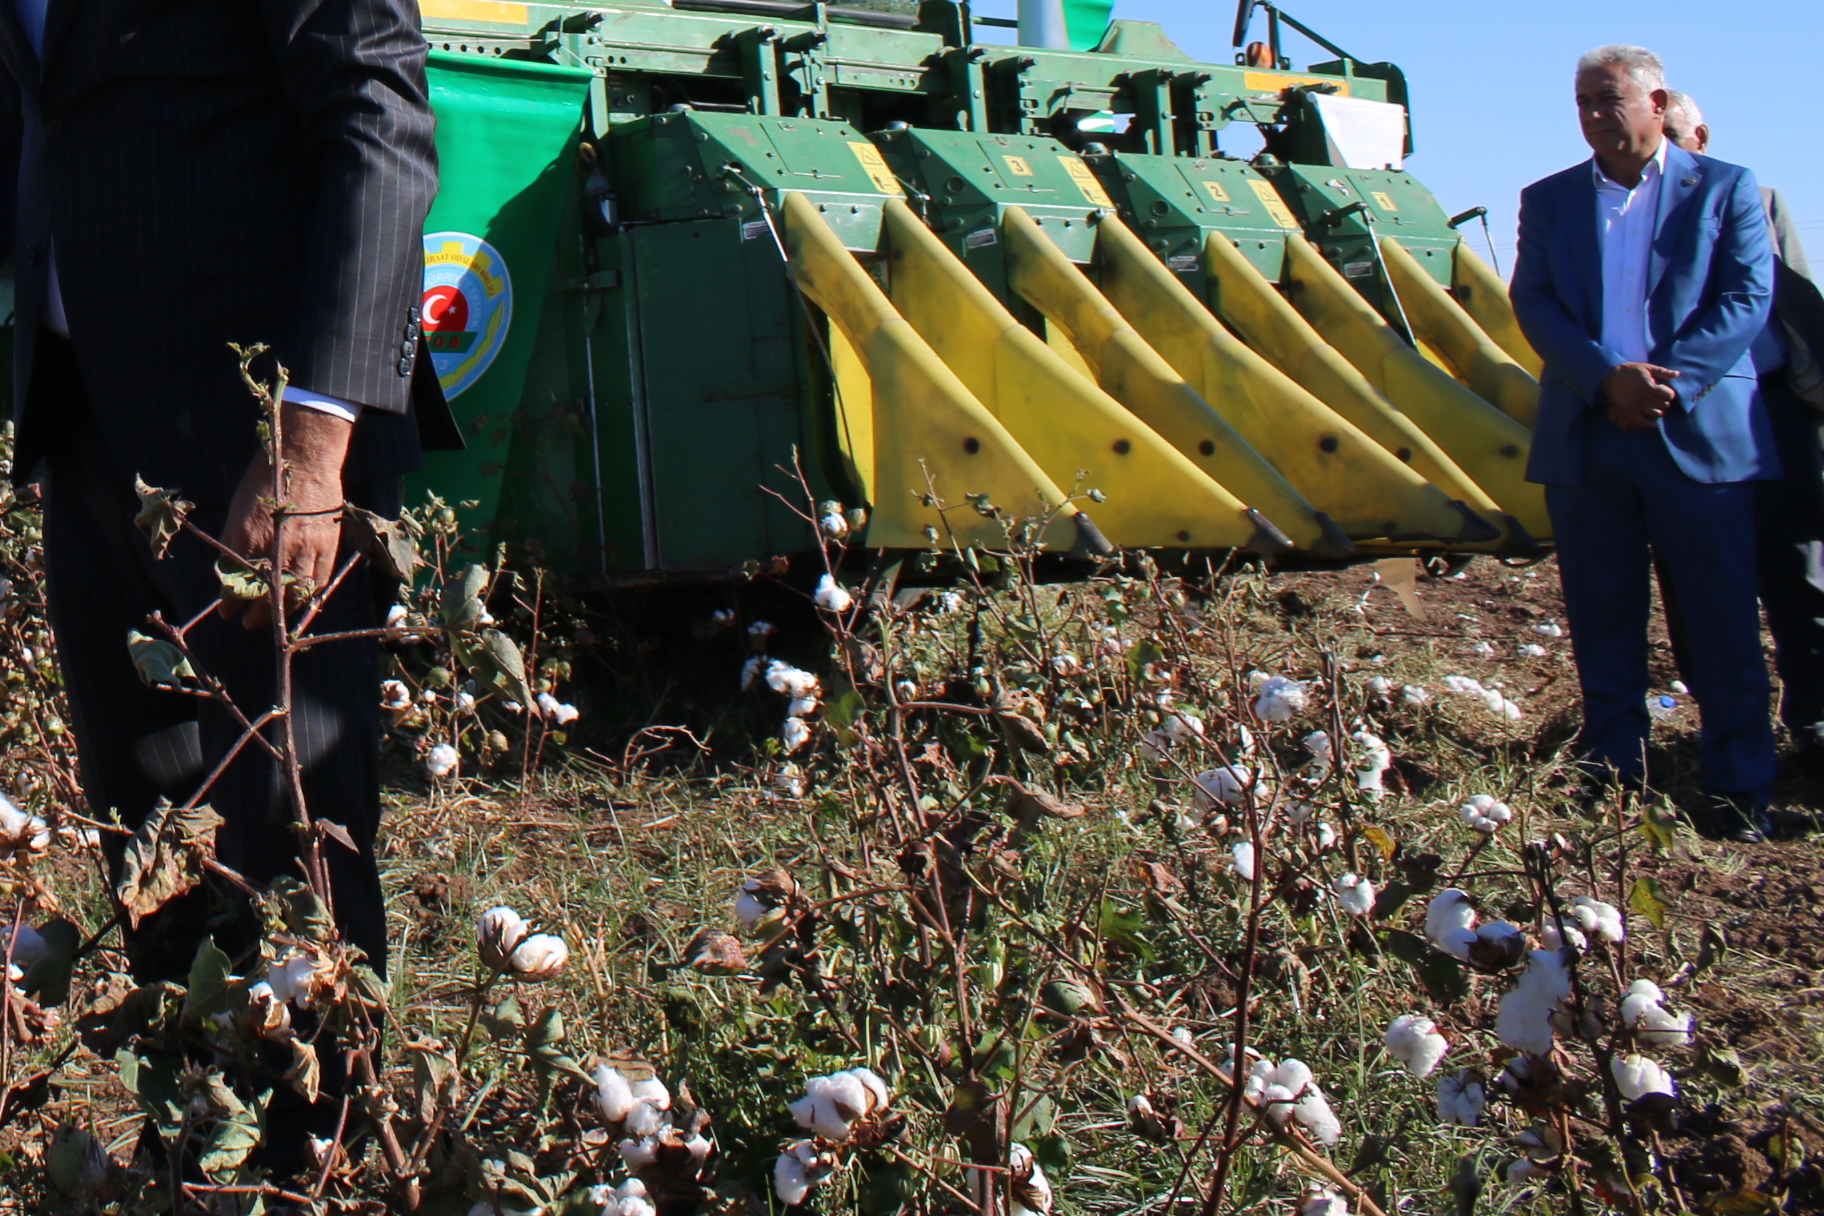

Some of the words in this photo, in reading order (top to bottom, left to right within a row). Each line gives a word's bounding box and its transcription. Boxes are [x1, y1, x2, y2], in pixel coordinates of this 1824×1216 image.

[1010, 159, 1024, 172] 3
[1209, 185, 1224, 197] 2
[1381, 195, 1393, 208] 1
[426, 253, 450, 264] İRAAT
[426, 334, 461, 349] OB
